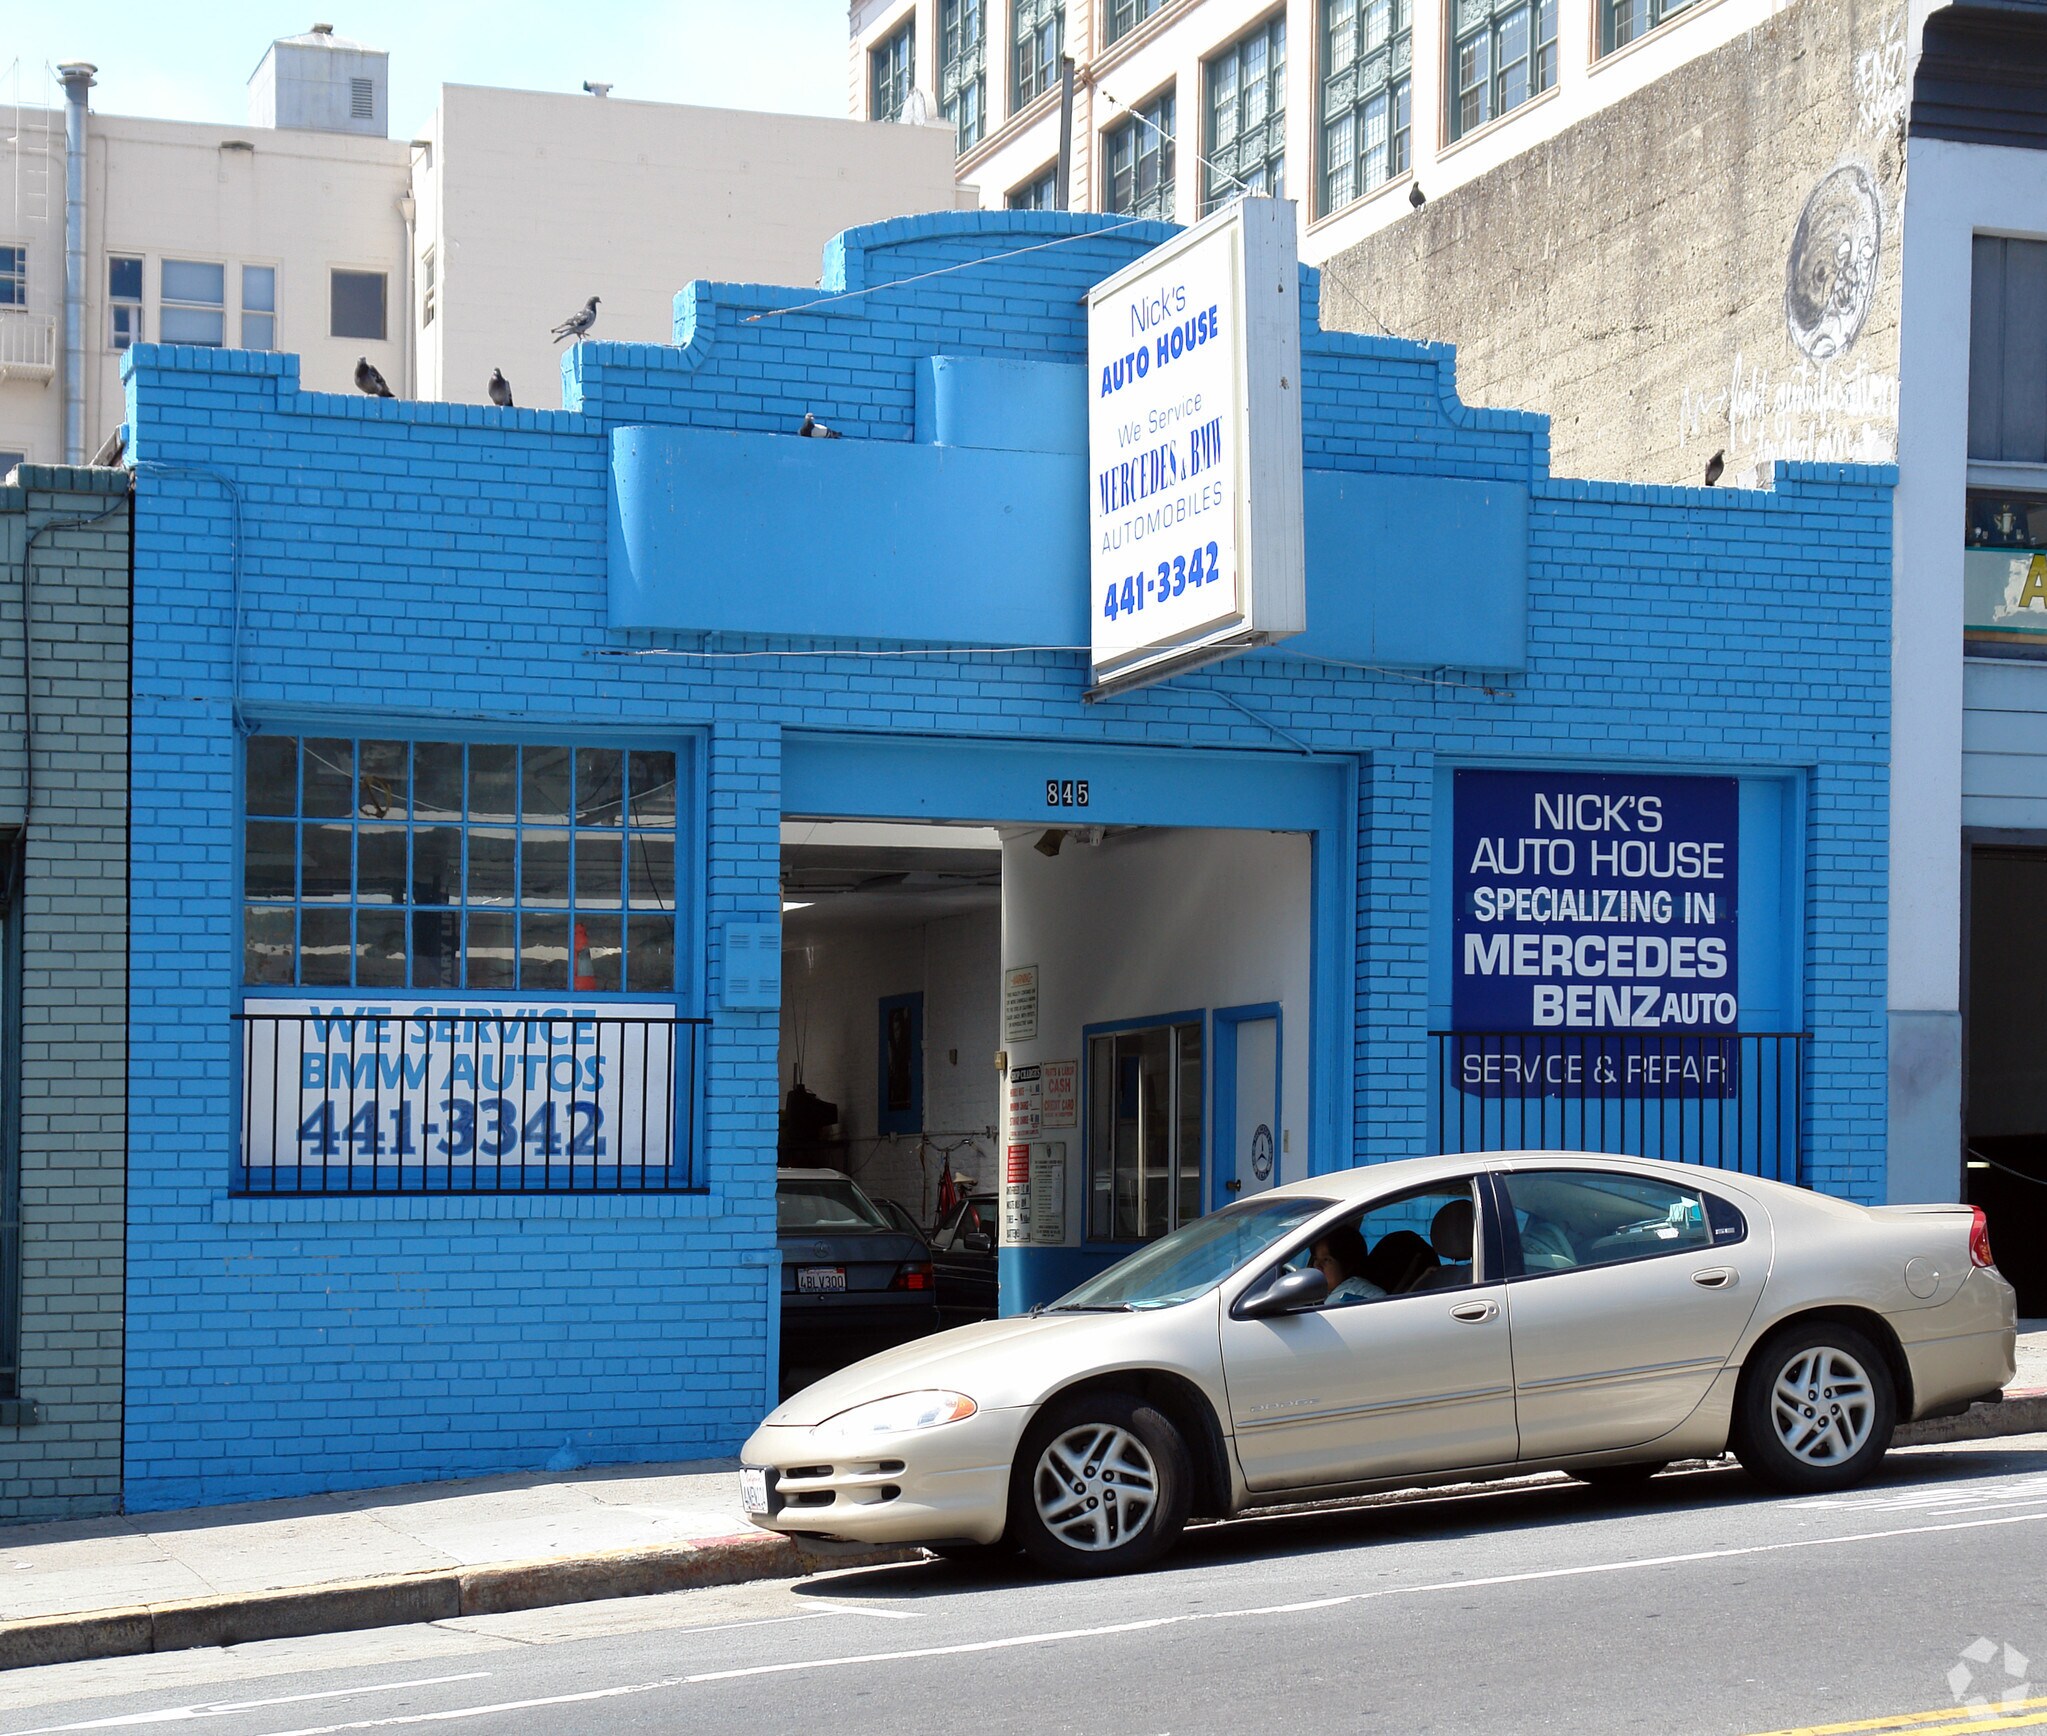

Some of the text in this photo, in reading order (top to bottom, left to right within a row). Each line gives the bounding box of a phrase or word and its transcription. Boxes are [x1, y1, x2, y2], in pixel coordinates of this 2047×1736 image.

[1131, 285, 1186, 338] Nick's
[1101, 304, 1218, 398] AUTO HOUSE
[1118, 393, 1202, 448] We Service
[1099, 415, 1223, 517] MERCEDES & BMW
[1102, 481, 1222, 555] AUTOMOBILES
[1104, 541, 1219, 621] 441-3342
[1047, 782, 1088, 805] 845
[1534, 793, 1663, 833] NICK'S
[1470, 837, 1725, 879] AUTO HOUSE
[1473, 886, 1716, 924] SPECIALIZING IN
[1464, 933, 1728, 978] MERCEDES
[310, 1006, 597, 1046] WE SERVICE
[1533, 984, 1737, 1027] BENZ AUTO
[302, 1052, 607, 1093] BMW AUTOS
[1049, 1079, 1071, 1093] CASH
[1463, 1054, 1726, 1083] SERVCE & REPAR
[296, 1098, 607, 1156] 441-3342
[800, 1275, 844, 1288] 4BLV300
